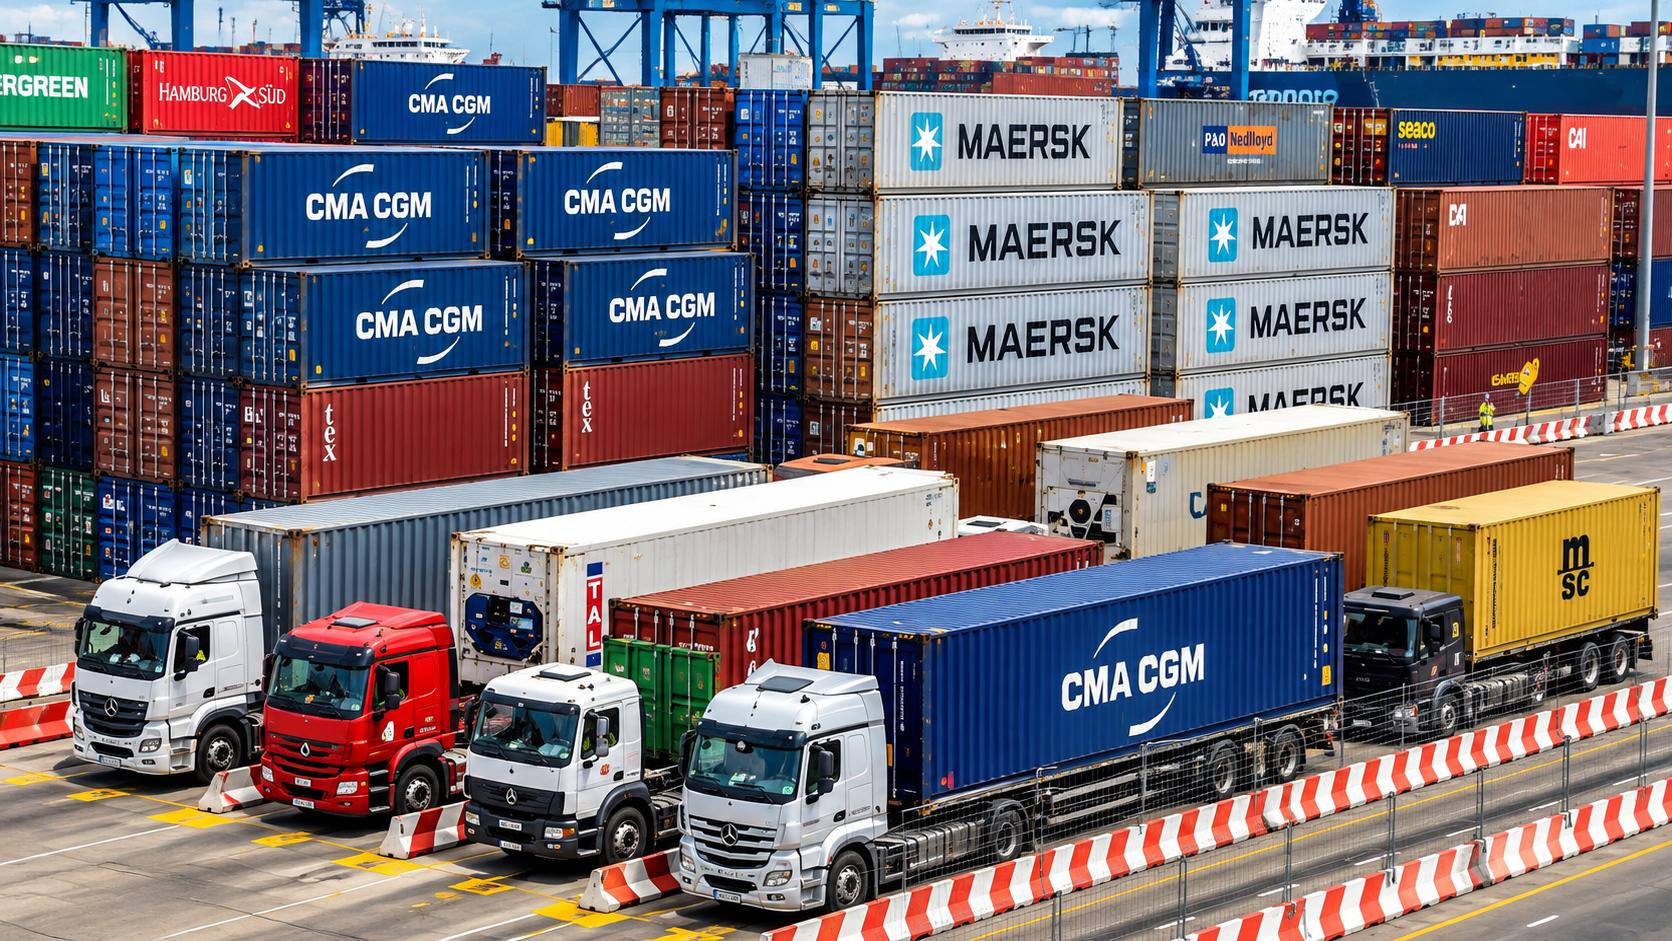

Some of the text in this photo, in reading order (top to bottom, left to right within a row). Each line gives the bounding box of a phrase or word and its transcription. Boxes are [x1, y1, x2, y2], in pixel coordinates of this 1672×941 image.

[0, 74, 88, 98] RGREEN
[159, 82, 286, 104] HAMBURG SÜD
[408, 94, 491, 114] CMA CGM
[958, 123, 1091, 160] MAERSK
[1230, 131, 1273, 150] Nedlloyd
[1398, 121, 1436, 139] seaco
[306, 192, 432, 221] CMA CGM
[564, 188, 671, 215] CMA CGM
[968, 220, 1121, 262] MAERSK
[1252, 212, 1369, 250] MAERSK
[356, 304, 483, 340] CMA CGM
[609, 292, 715, 323] CMA CGM
[1250, 297, 1367, 339] MAERSK
[967, 315, 1120, 364] MAERSK
[582, 380, 593, 433] tex
[322, 403, 337, 462] tex
[587, 580, 602, 648] TAL
[1061, 642, 1205, 712] CMA CGM
